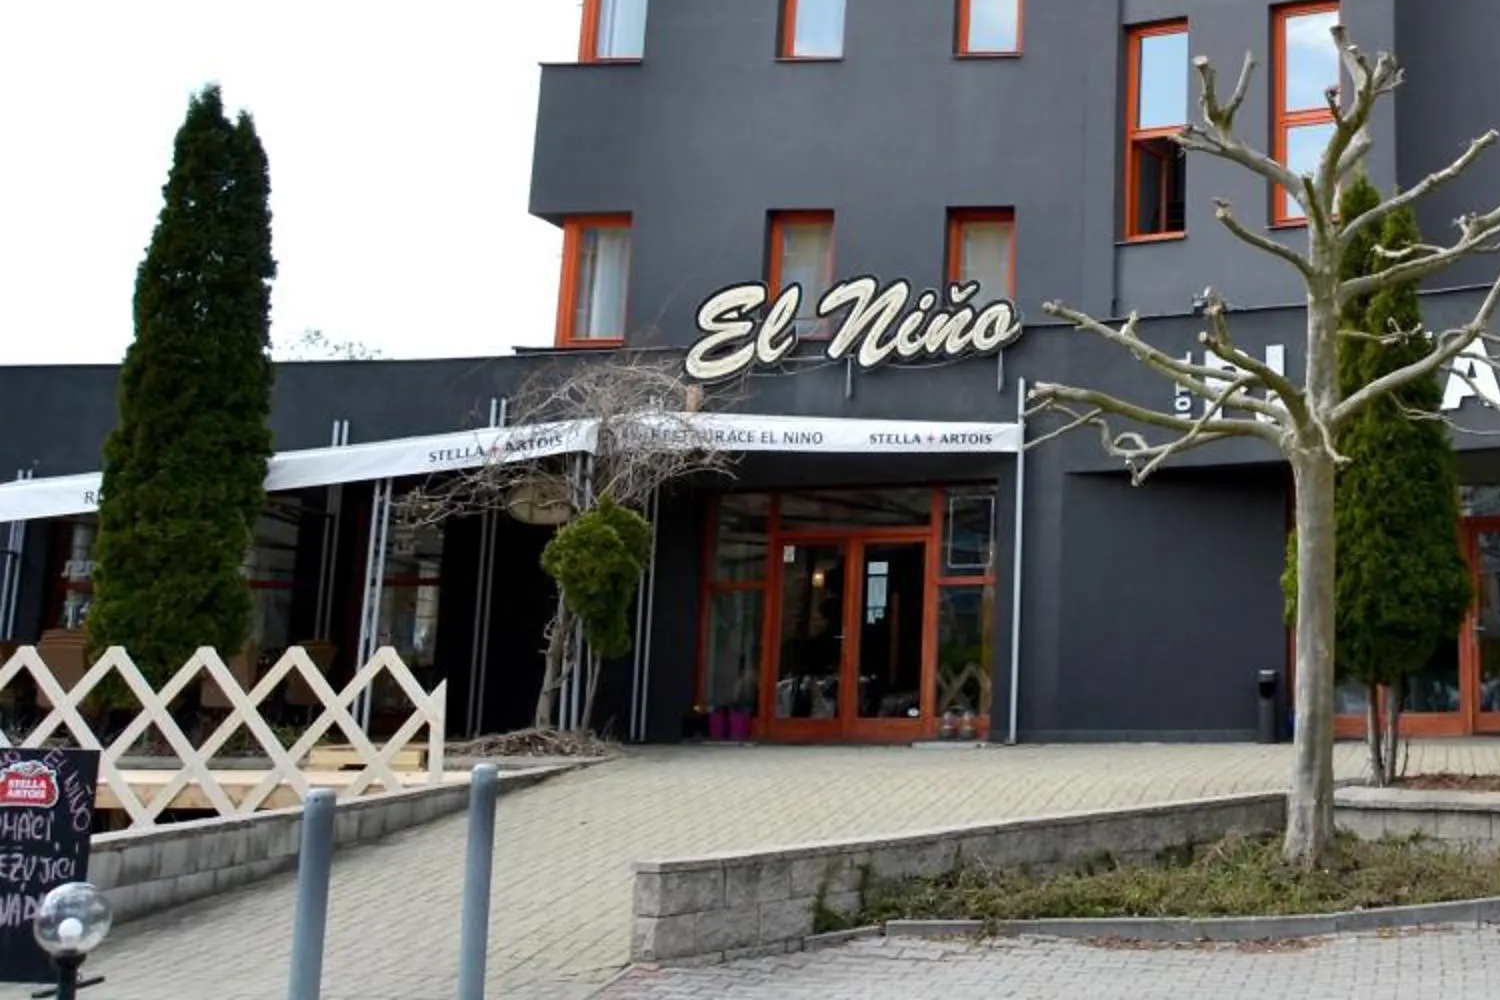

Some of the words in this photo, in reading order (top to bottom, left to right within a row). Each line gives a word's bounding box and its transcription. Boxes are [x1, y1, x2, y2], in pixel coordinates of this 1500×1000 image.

[684, 283, 802, 382] El
[761, 430, 777, 444] EL
[869, 433, 921, 445] STELLA
[940, 433, 992, 445] ARTOIS
[428, 445, 485, 462] STELLA
[504, 435, 563, 452] ARTOIS
[8, 779, 47, 788] STELLA
